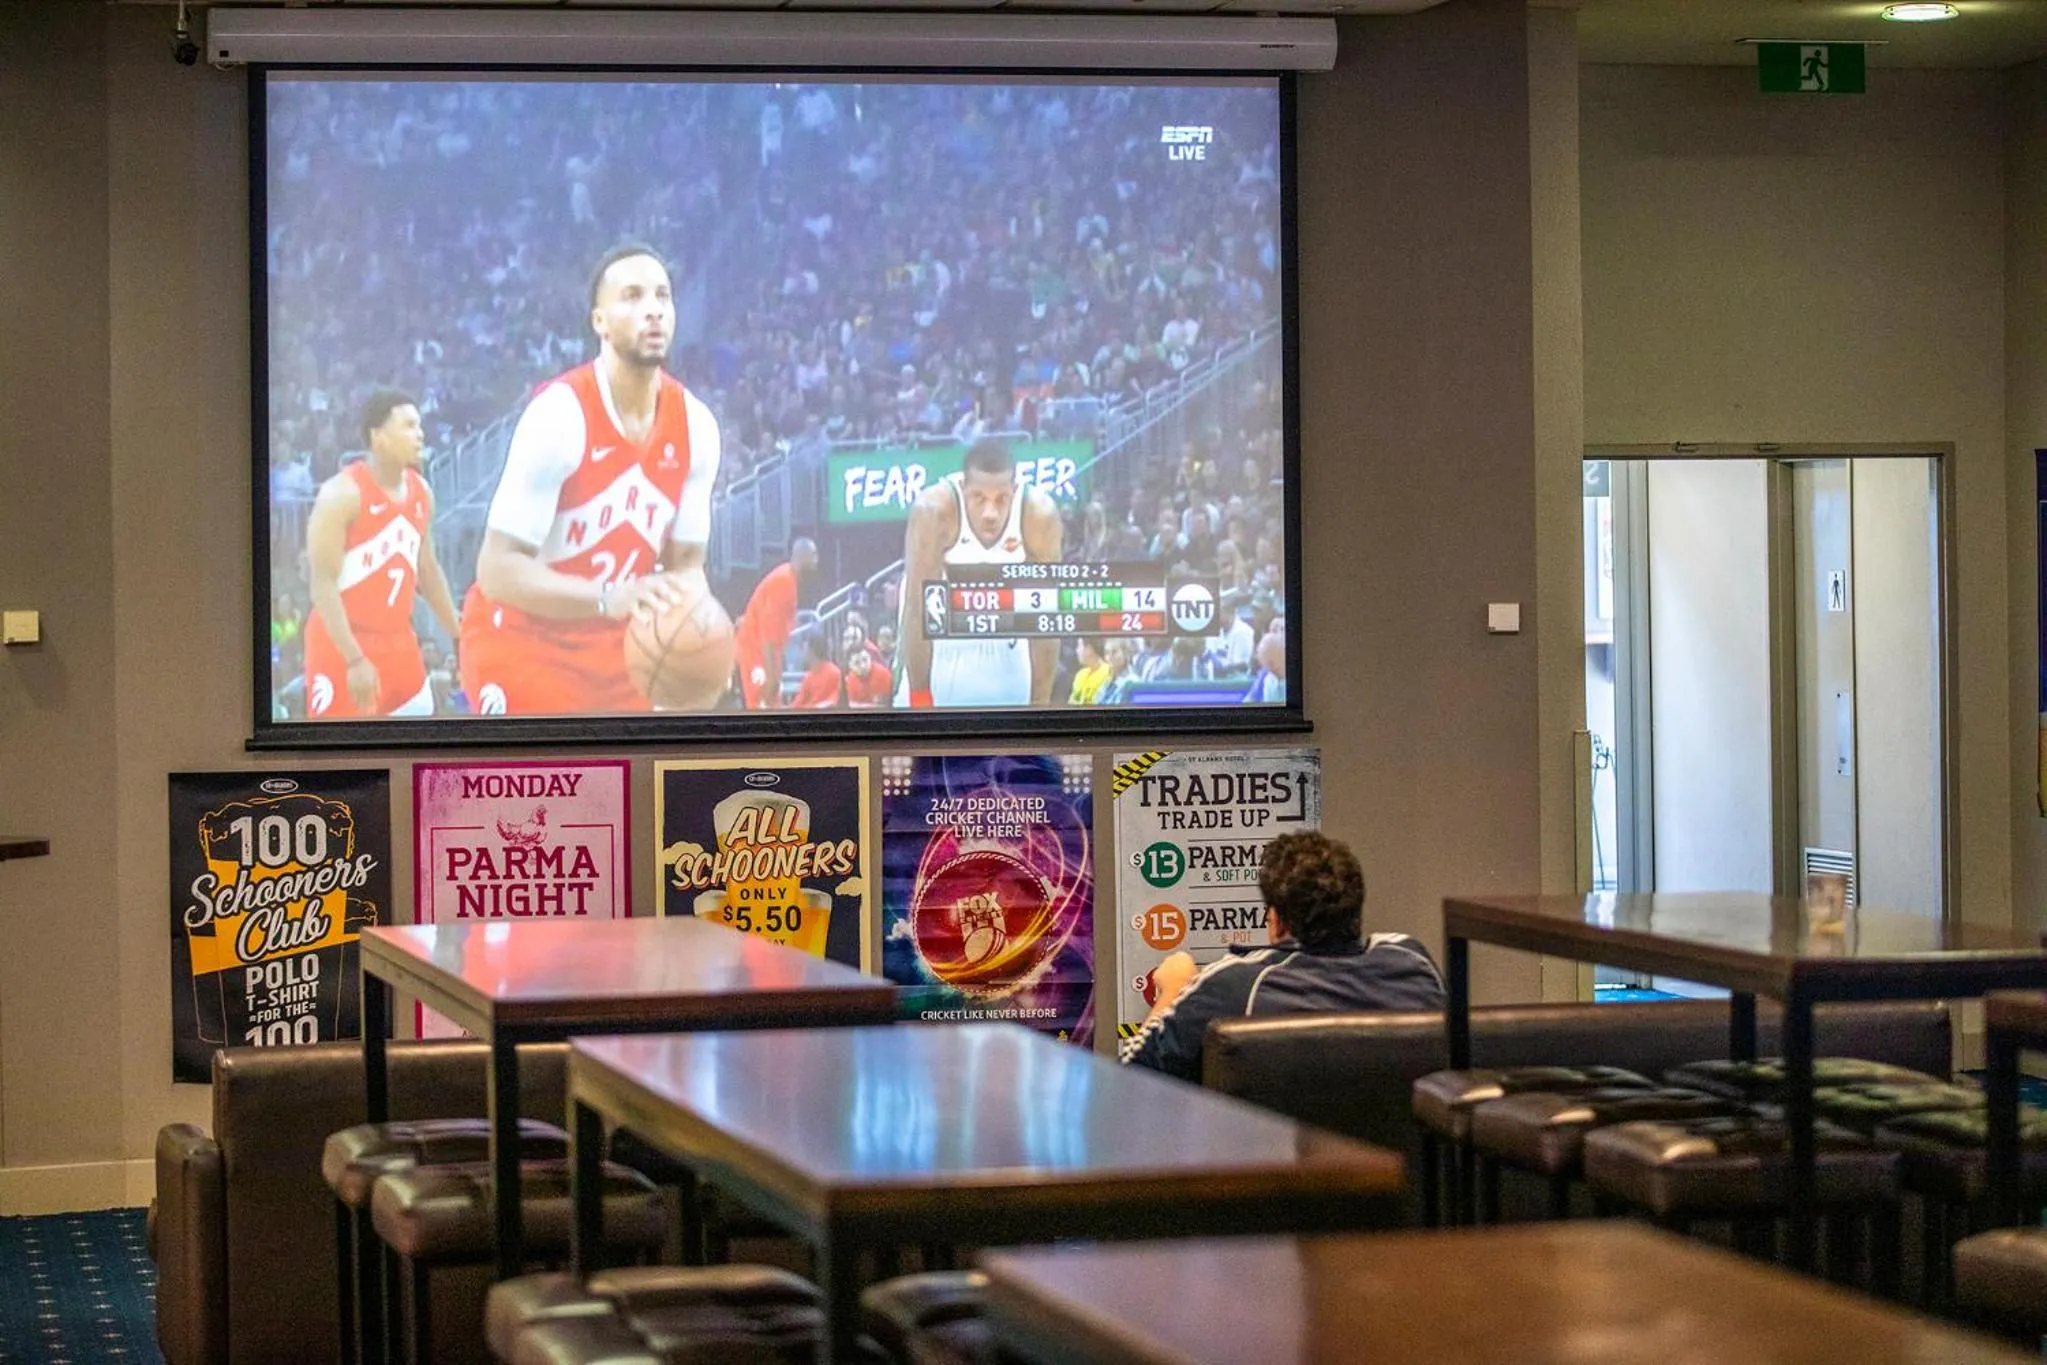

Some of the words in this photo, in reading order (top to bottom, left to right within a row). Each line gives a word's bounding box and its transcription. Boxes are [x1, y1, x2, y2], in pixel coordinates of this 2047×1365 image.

[1161, 126, 1213, 143] ESPN
[1168, 145, 1206, 160] LIVE
[844, 463, 927, 513] FEAR
[1001, 564, 1048, 579] SERIES
[1051, 564, 1079, 579] TIED
[387, 567, 405, 607] 7
[960, 592, 1001, 611] TOR
[1030, 591, 1042, 608] 3
[1070, 591, 1108, 610] MIL
[1133, 590, 1156, 608] 14
[1171, 599, 1215, 619] TNT
[966, 616, 999, 633] 1ST
[1037, 615, 1076, 632] 8:18
[1121, 613, 1143, 631] 24
[461, 774, 583, 799] MONDAY
[1138, 772, 1292, 807] TRADIES
[931, 799, 963, 811] 24/7
[967, 797, 1045, 811] DEDICATED
[726, 806, 801, 847] ALL
[925, 812, 983, 826] CRICKET
[987, 811, 1051, 825] CHANNEL
[1157, 809, 1233, 830] TRADE
[1240, 808, 1271, 828] UP
[230, 814, 327, 866] 100
[954, 826, 984, 839] LIVE
[987, 825, 1022, 838] HERE
[446, 846, 600, 881] PARMA
[671, 838, 857, 890] SCHOONERS
[1215, 868, 1240, 881] SOFT
[1244, 868, 1259, 881] PO
[184, 854, 379, 928] Schooners
[456, 882, 594, 918] NIGHT
[740, 887, 787, 900] ONLY
[723, 904, 802, 933] $5.50
[236, 899, 329, 962] Club
[245, 953, 320, 994] POLO
[246, 981, 320, 1012] T-SHIRT
[257, 1008, 281, 1023] FOR
[285, 1001, 309, 1018] THE
[920, 1010, 962, 1021] CRICKET
[963, 1009, 984, 1020] LIKE
[986, 1008, 1017, 1020] NEVER
[1019, 1007, 1057, 1019] BEFORE
